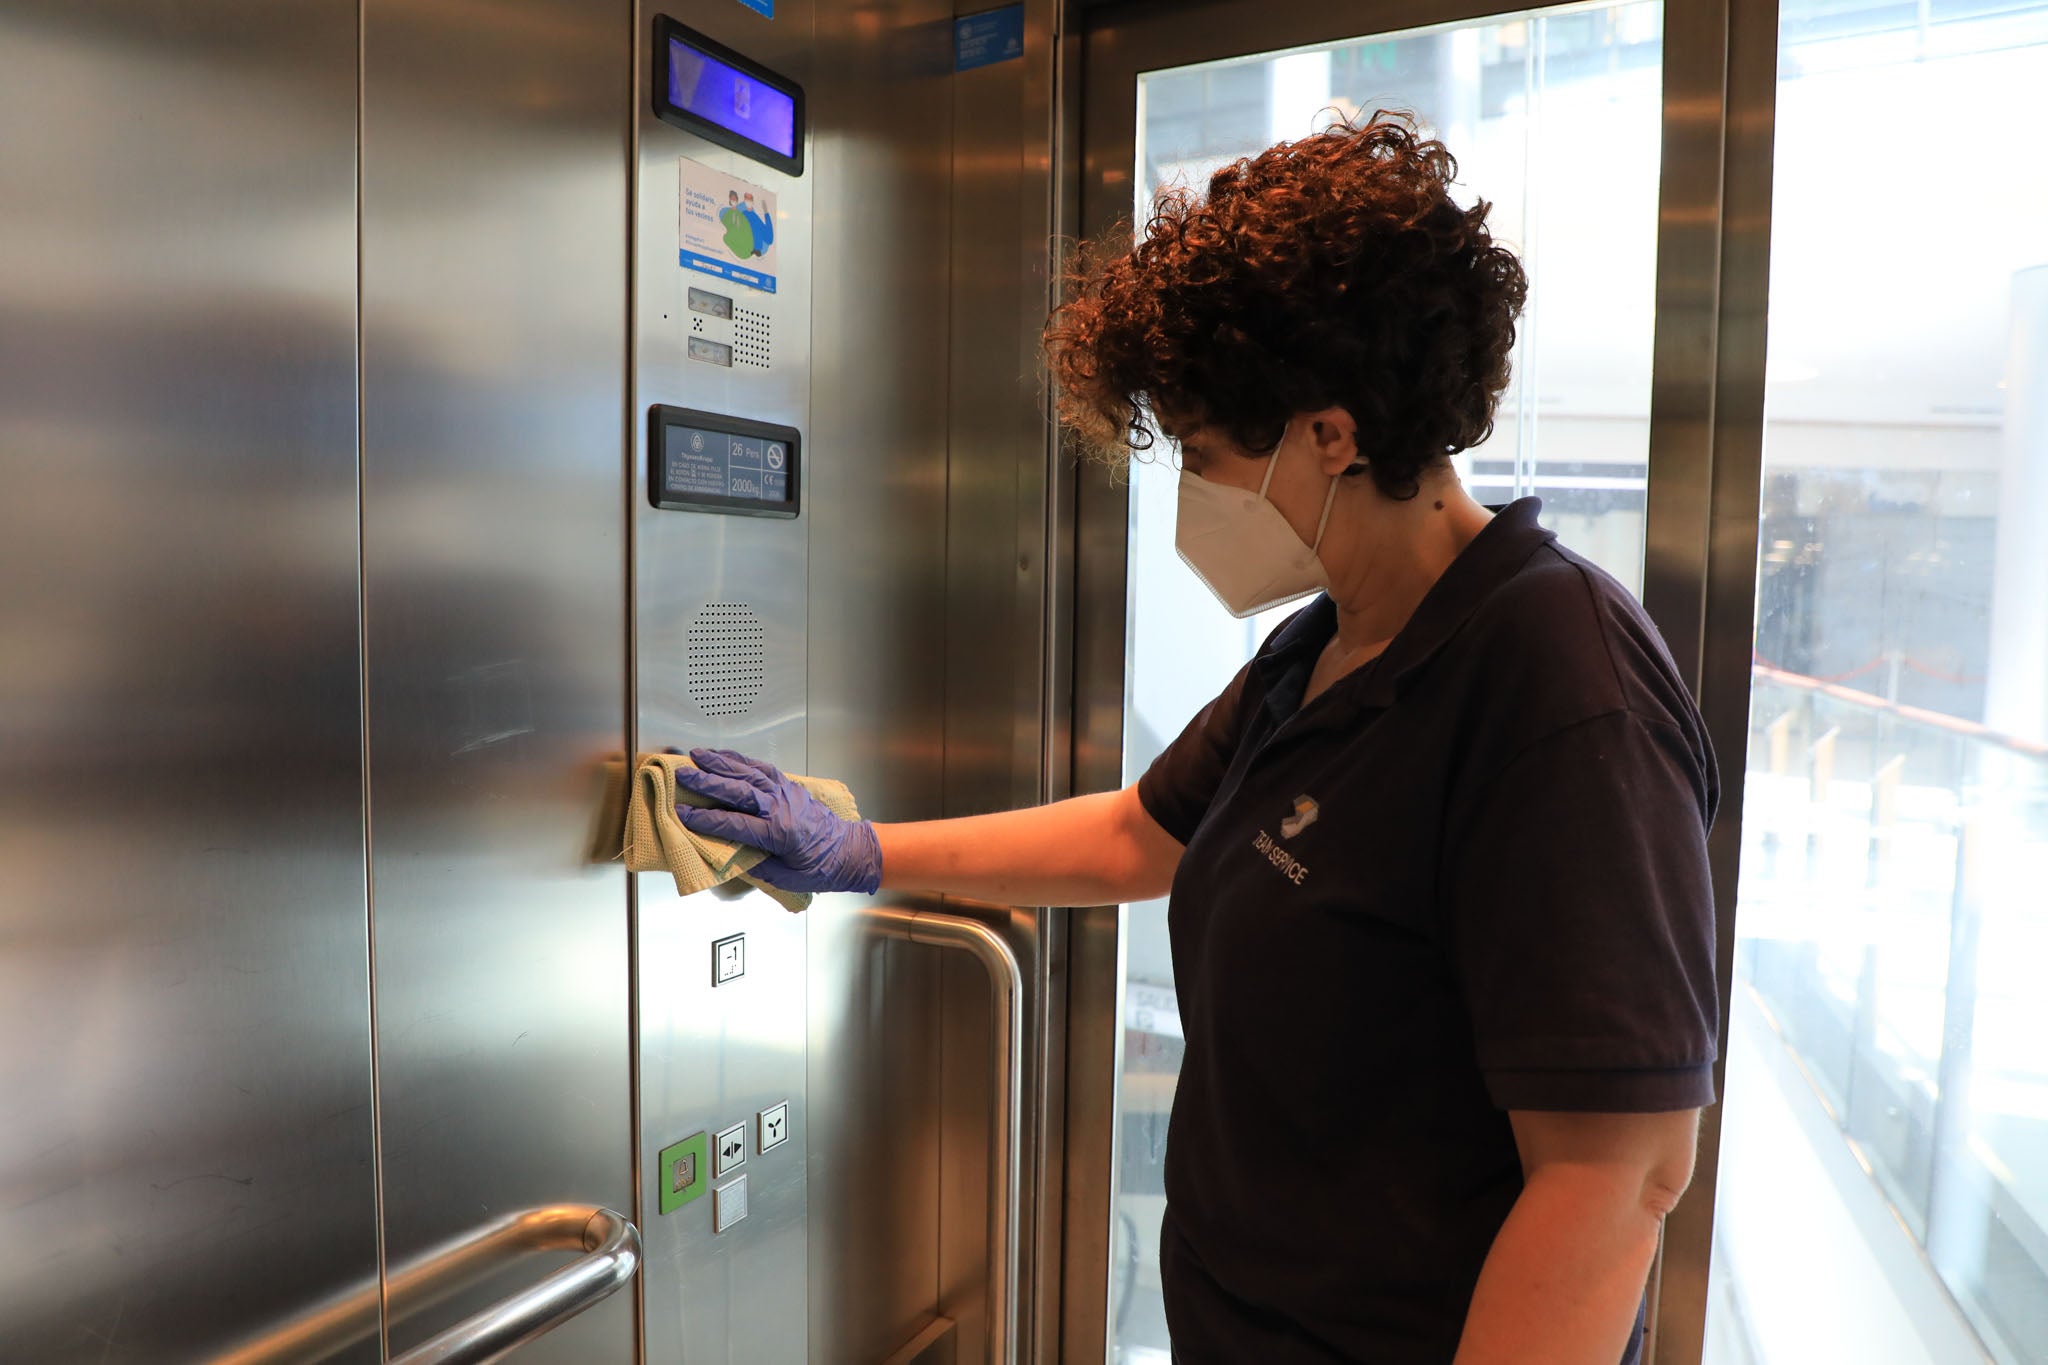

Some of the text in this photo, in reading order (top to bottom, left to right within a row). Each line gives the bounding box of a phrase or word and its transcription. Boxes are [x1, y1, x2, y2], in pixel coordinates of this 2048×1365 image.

[732, 442, 743, 457] 26
[1268, 846, 1309, 885] SERVICE
[726, 946, 736, 961] -1
